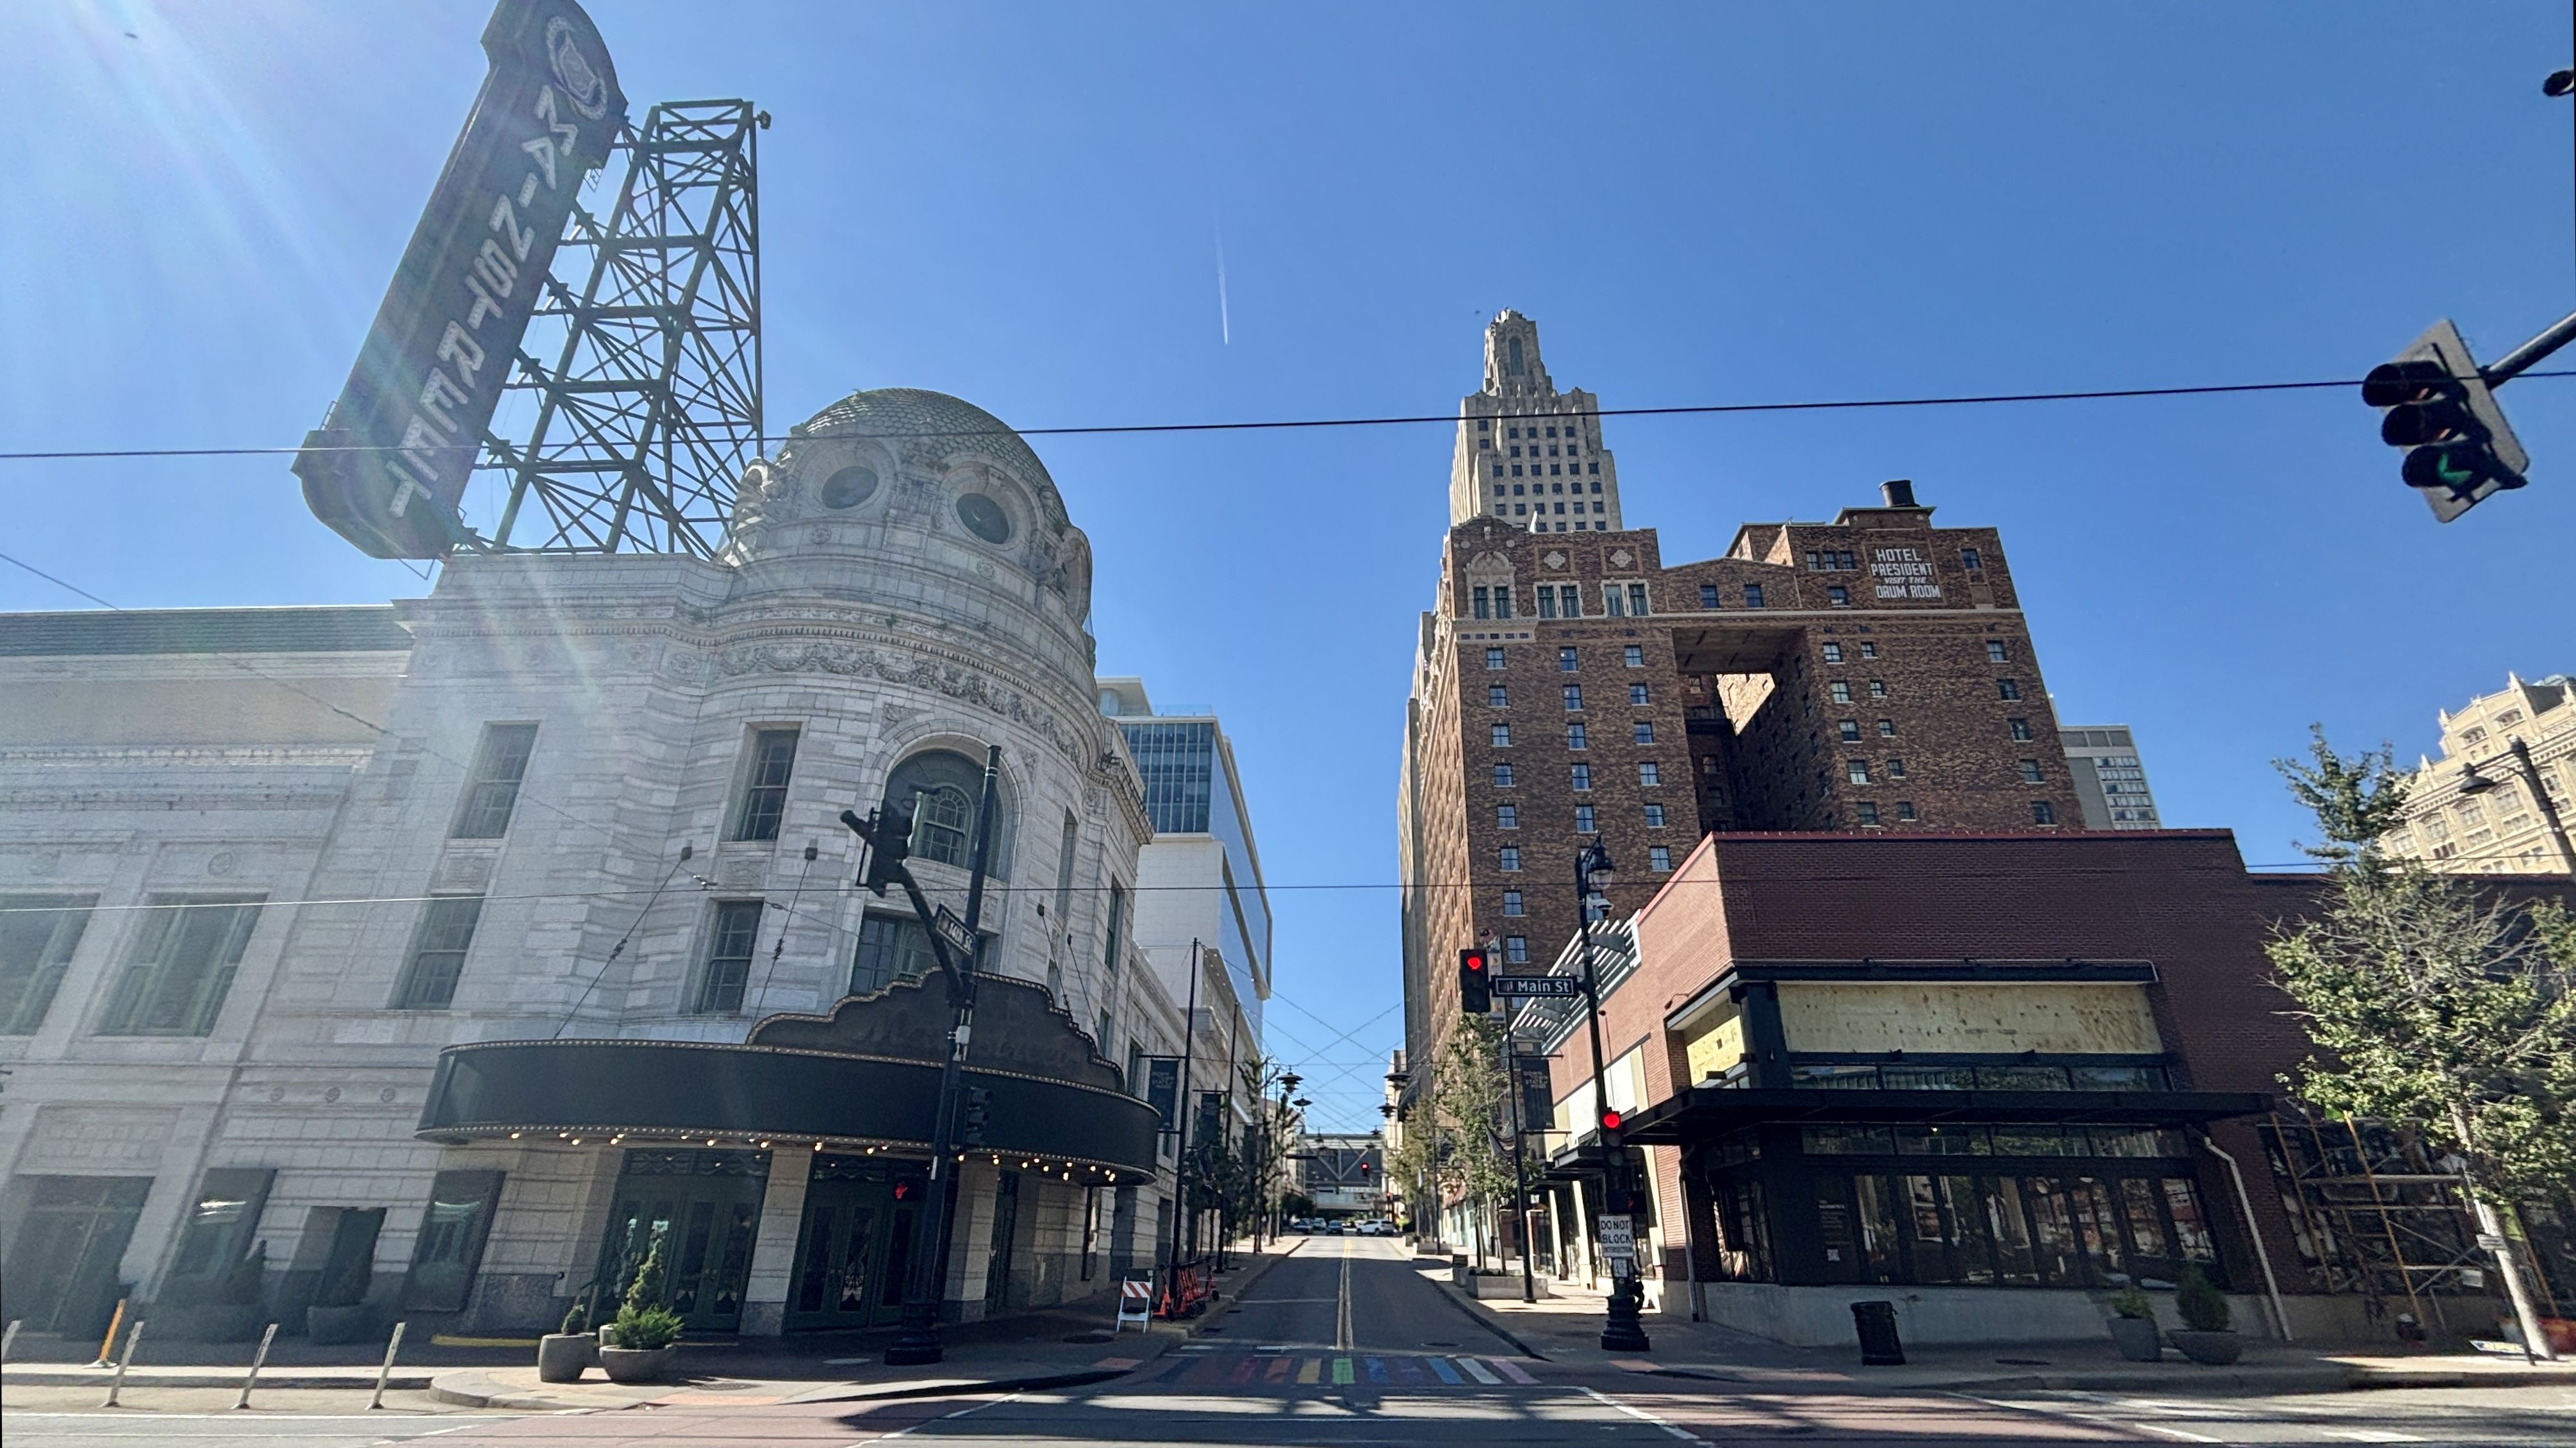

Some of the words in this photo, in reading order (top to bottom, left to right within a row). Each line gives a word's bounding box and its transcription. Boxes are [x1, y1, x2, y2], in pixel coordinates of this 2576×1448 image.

[1875, 548, 1922, 562] HOTEL
[1870, 563, 1933, 576] PRESIDENT
[1884, 576, 1906, 584] VISIT
[1875, 585, 1908, 598] DRUM
[1910, 584, 1941, 598] ROOM
[1517, 980, 1551, 992] Main
[1555, 981, 1569, 992] St
[1601, 1220, 1612, 1230] DO
[1613, 1220, 1630, 1230] NOT
[1602, 1234, 1632, 1244] BLOCK
